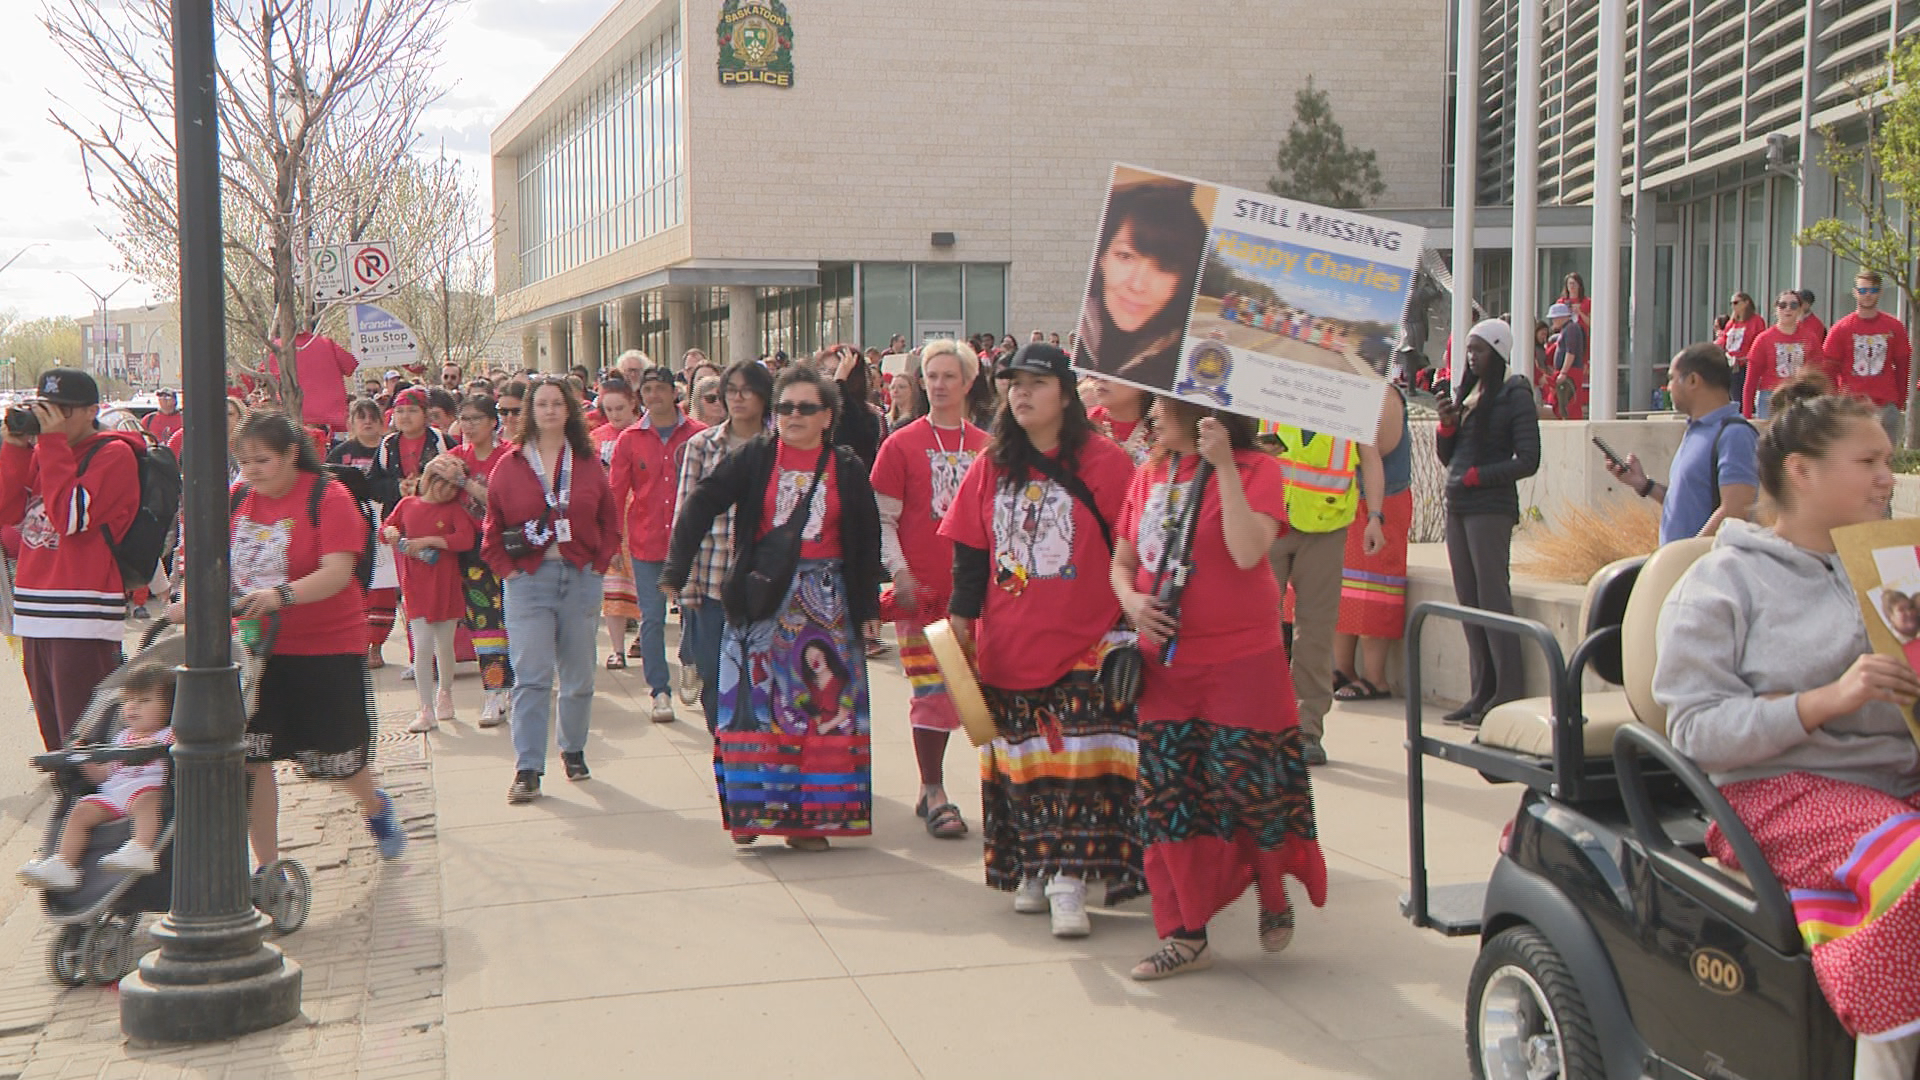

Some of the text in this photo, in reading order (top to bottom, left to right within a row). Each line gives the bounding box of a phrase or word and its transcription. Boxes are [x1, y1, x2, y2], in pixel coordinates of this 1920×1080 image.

[725, 6, 785, 26] SASKATOON
[722, 70, 789, 86] POLICE
[1233, 198, 1402, 252] STILL MISSING
[1216, 231, 1300, 275] Happy
[1303, 252, 1402, 293] Charles
[360, 319, 394, 329] transit
[360, 331, 408, 344] Bus Stop
[1696, 953, 1738, 989] 600
